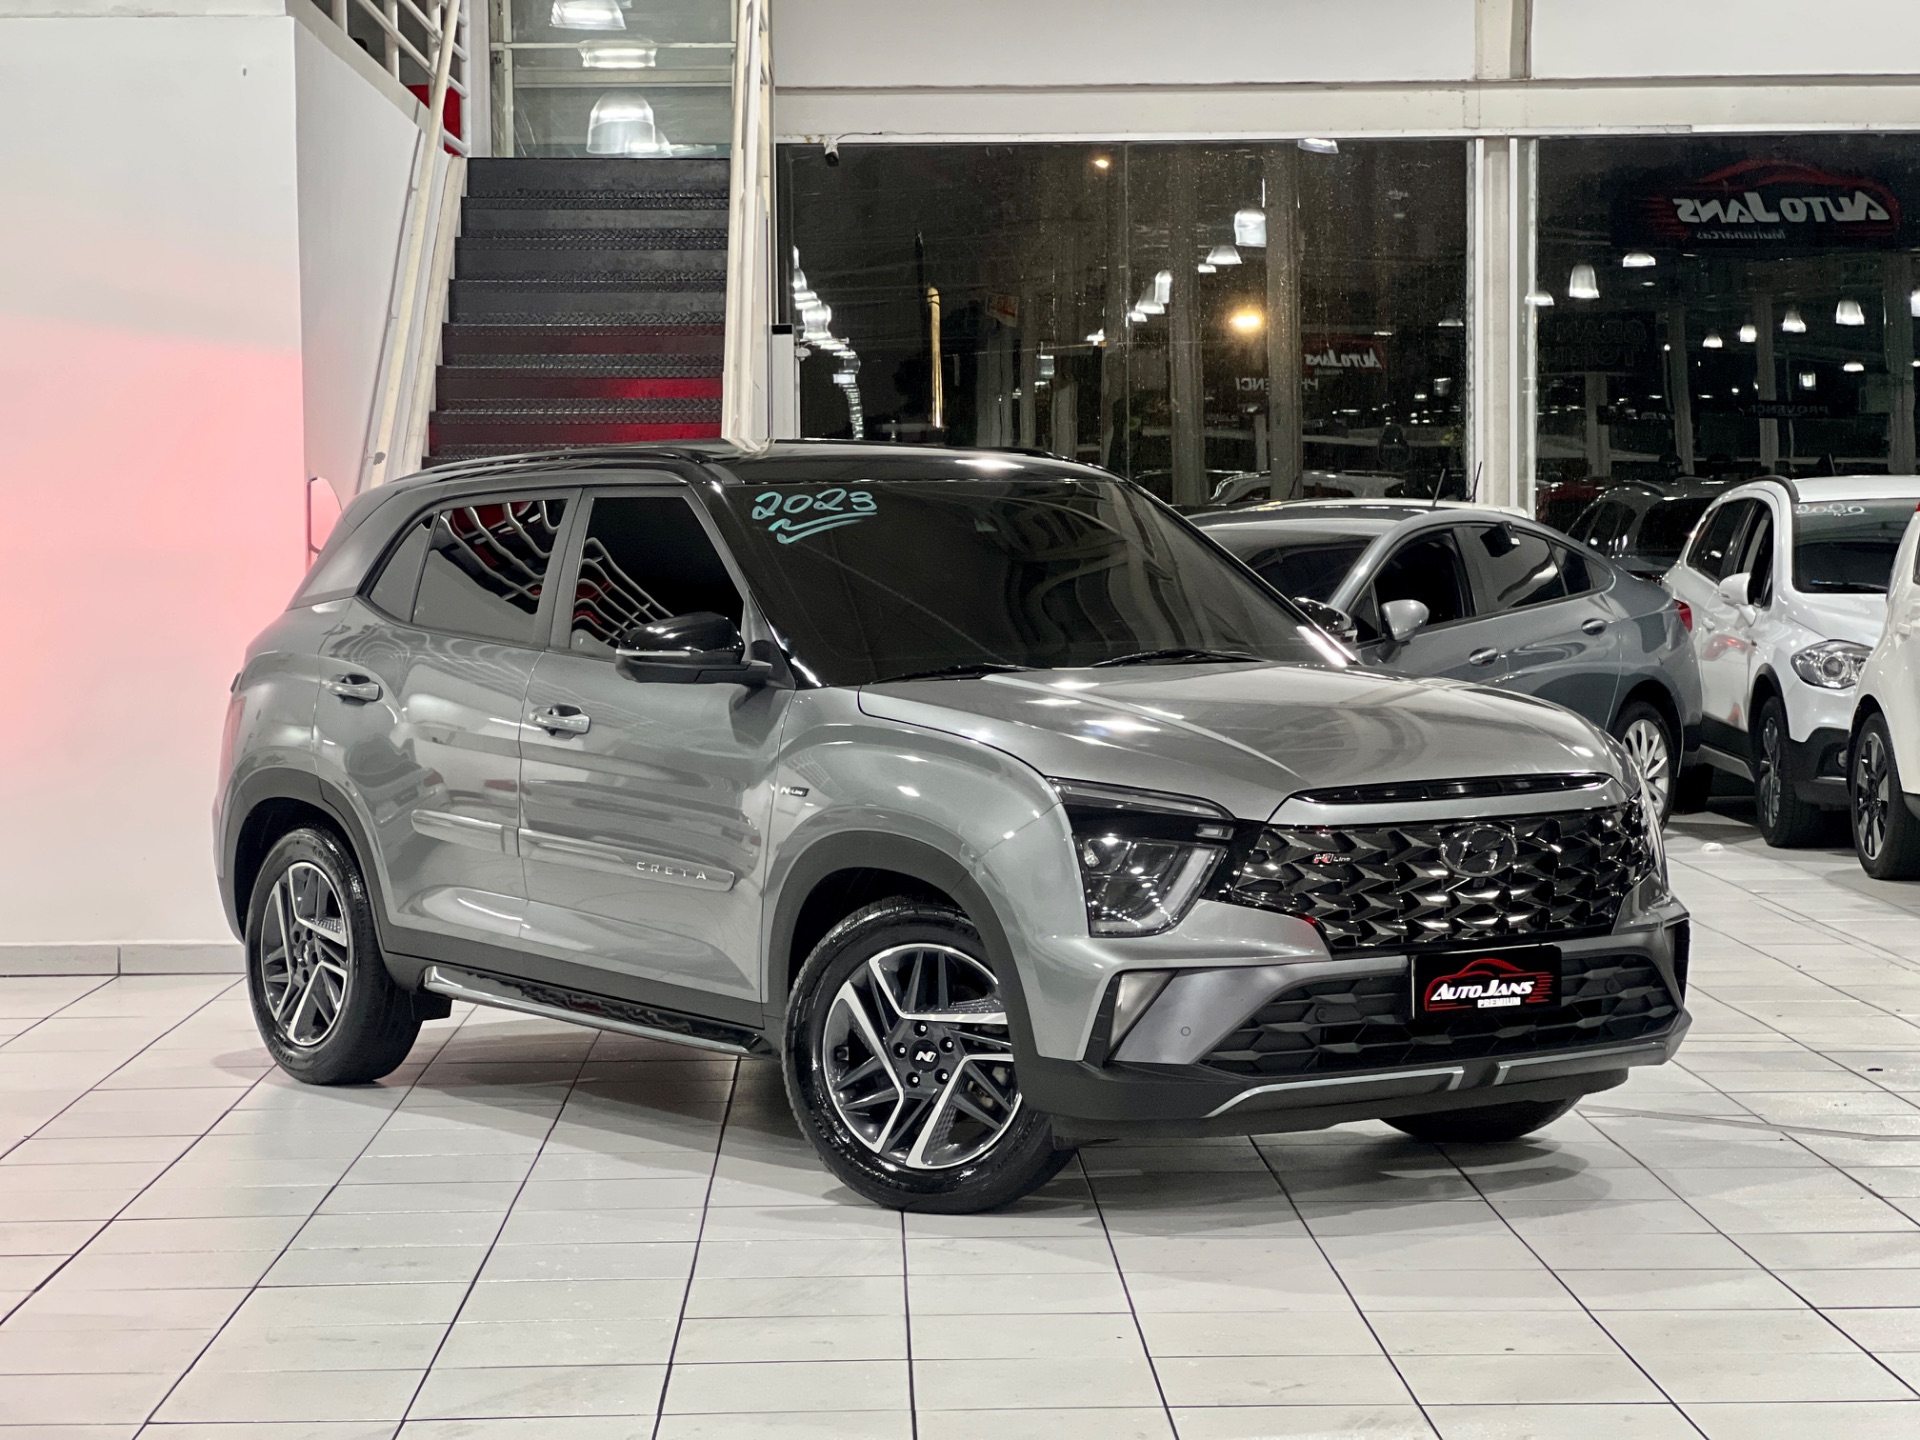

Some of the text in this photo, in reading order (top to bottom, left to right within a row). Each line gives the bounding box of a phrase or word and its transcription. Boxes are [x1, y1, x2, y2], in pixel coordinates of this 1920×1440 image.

[751, 487, 878, 520] 2023
[636, 861, 707, 880] CRETA
[1430, 979, 1535, 1001] AUTO JANS
[1477, 997, 1521, 1008] PREMIUM
